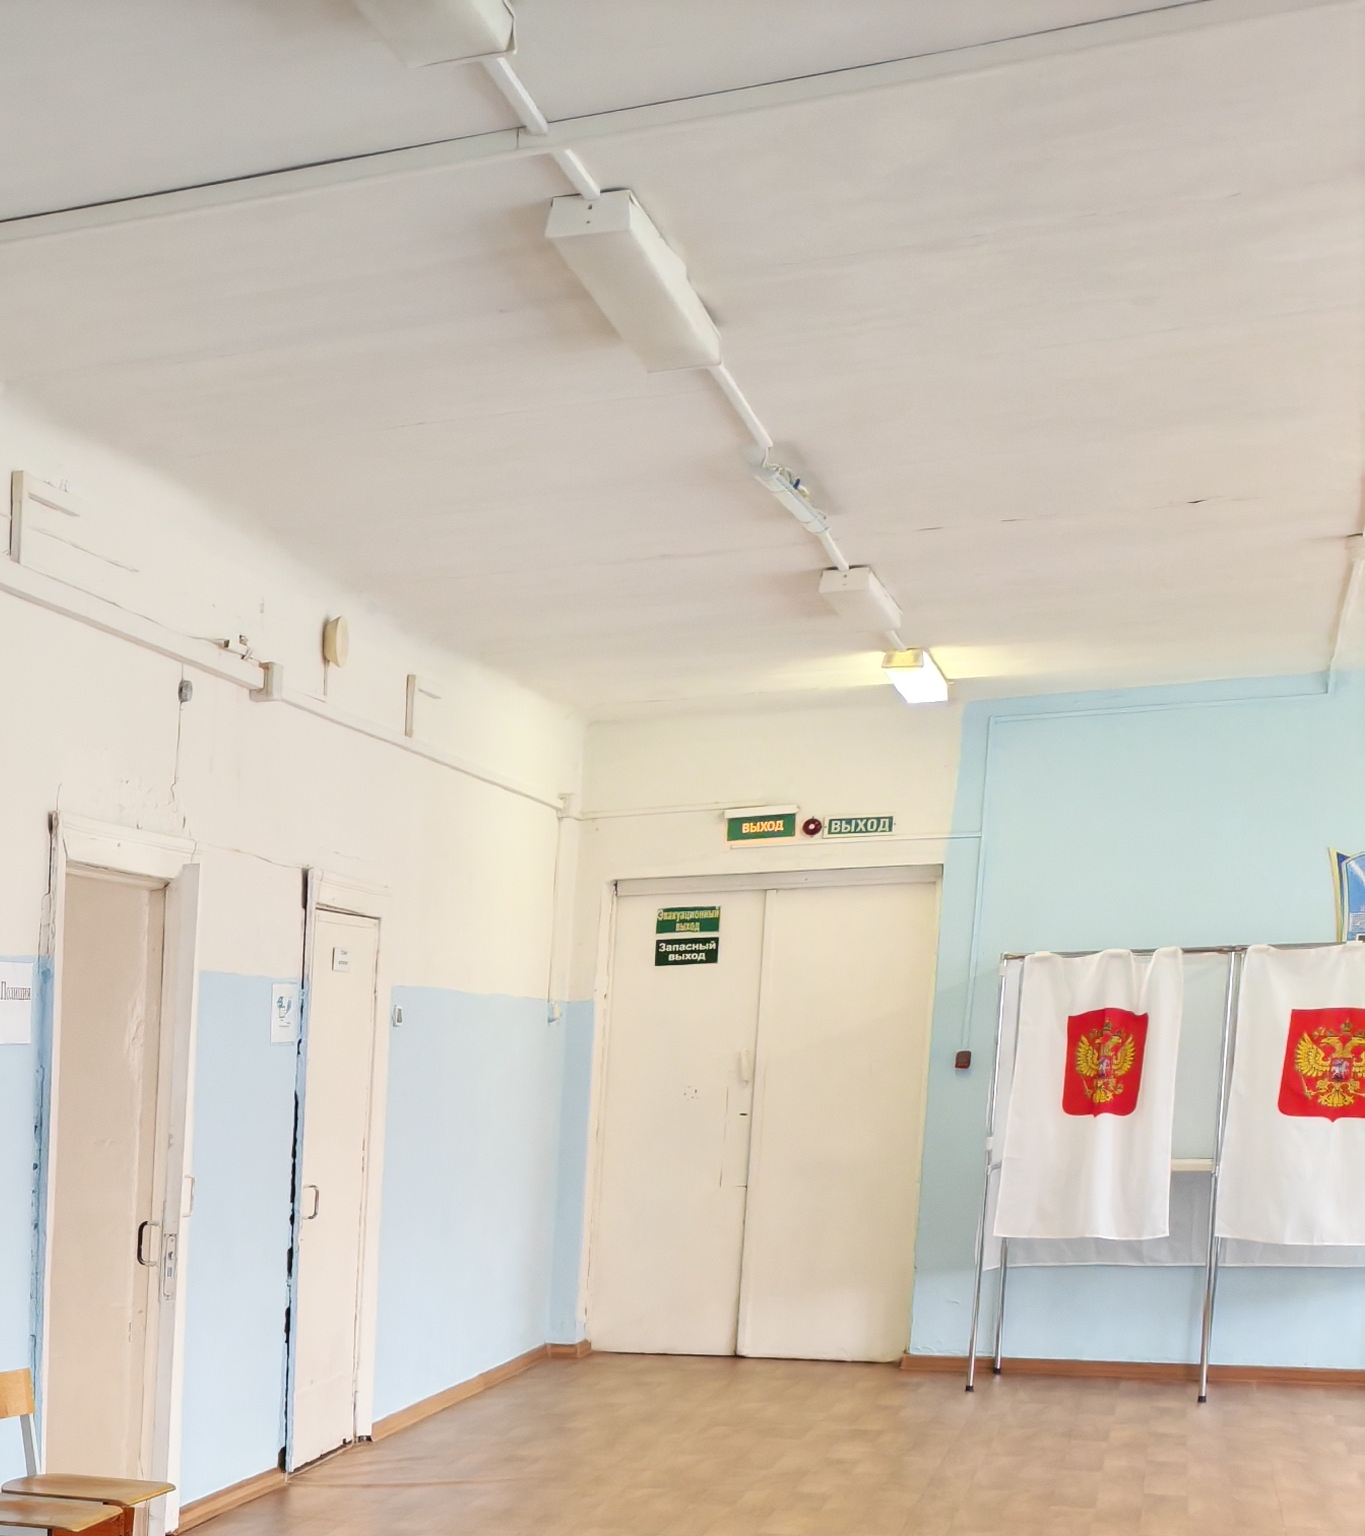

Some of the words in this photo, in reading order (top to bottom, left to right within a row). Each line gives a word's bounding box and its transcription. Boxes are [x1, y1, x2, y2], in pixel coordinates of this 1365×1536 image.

[741, 819, 785, 834] ВЫХОД
[830, 818, 892, 834] ВЫХОД
[658, 941, 717, 952] Запасный
[668, 952, 706, 962] выход
